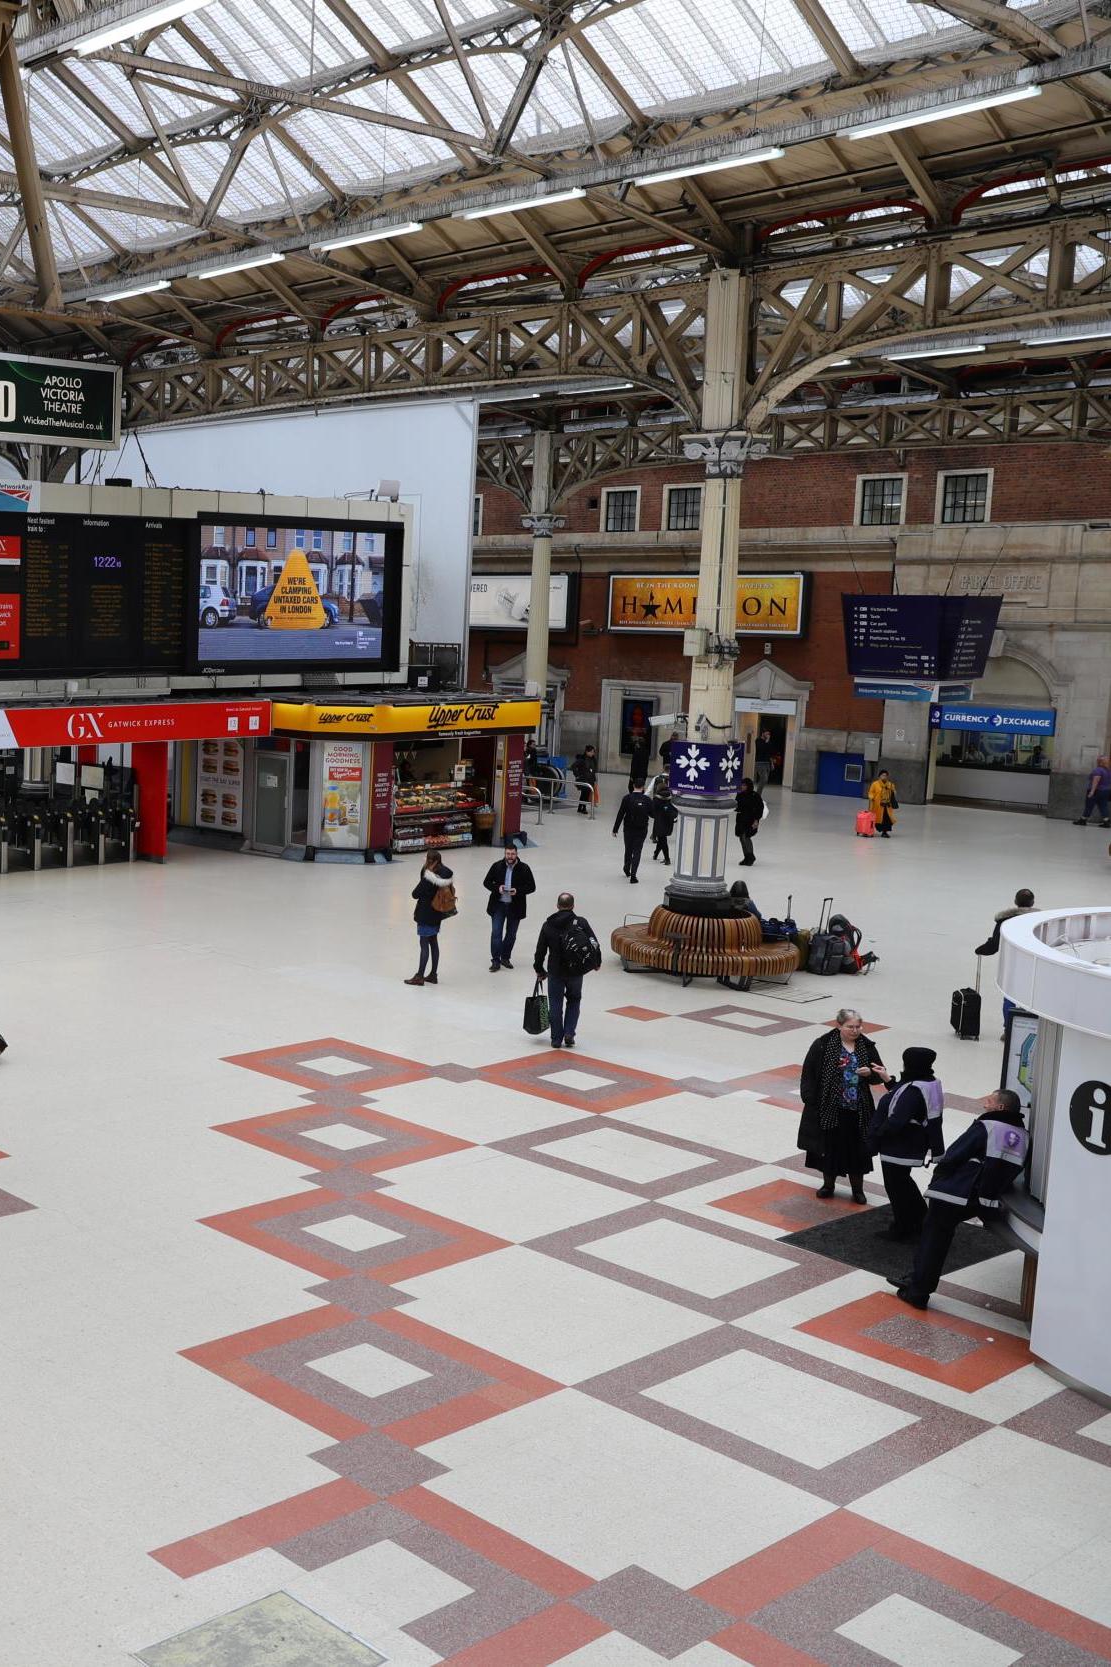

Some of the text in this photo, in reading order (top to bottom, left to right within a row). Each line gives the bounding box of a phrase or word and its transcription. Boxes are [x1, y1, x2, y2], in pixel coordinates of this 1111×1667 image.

[44, 376, 82, 388] APOLLO
[40, 388, 85, 401] VICTORIA
[44, 401, 82, 414] THEATRE
[23, 416, 104, 431] WickedTheMusical.co.uk
[281, 586, 312, 595] CLAMPING
[471, 584, 487, 593] ERED
[273, 596, 319, 604] UNTAXED CARS
[280, 605, 312, 614] IN LONDON
[318, 713, 373, 724] Upper Crust
[427, 703, 499, 729] Upper Crust
[944, 713, 1050, 727] CURRENCY EXCHANGE
[67, 712, 175, 739] GX GATWICK EXPRESS
